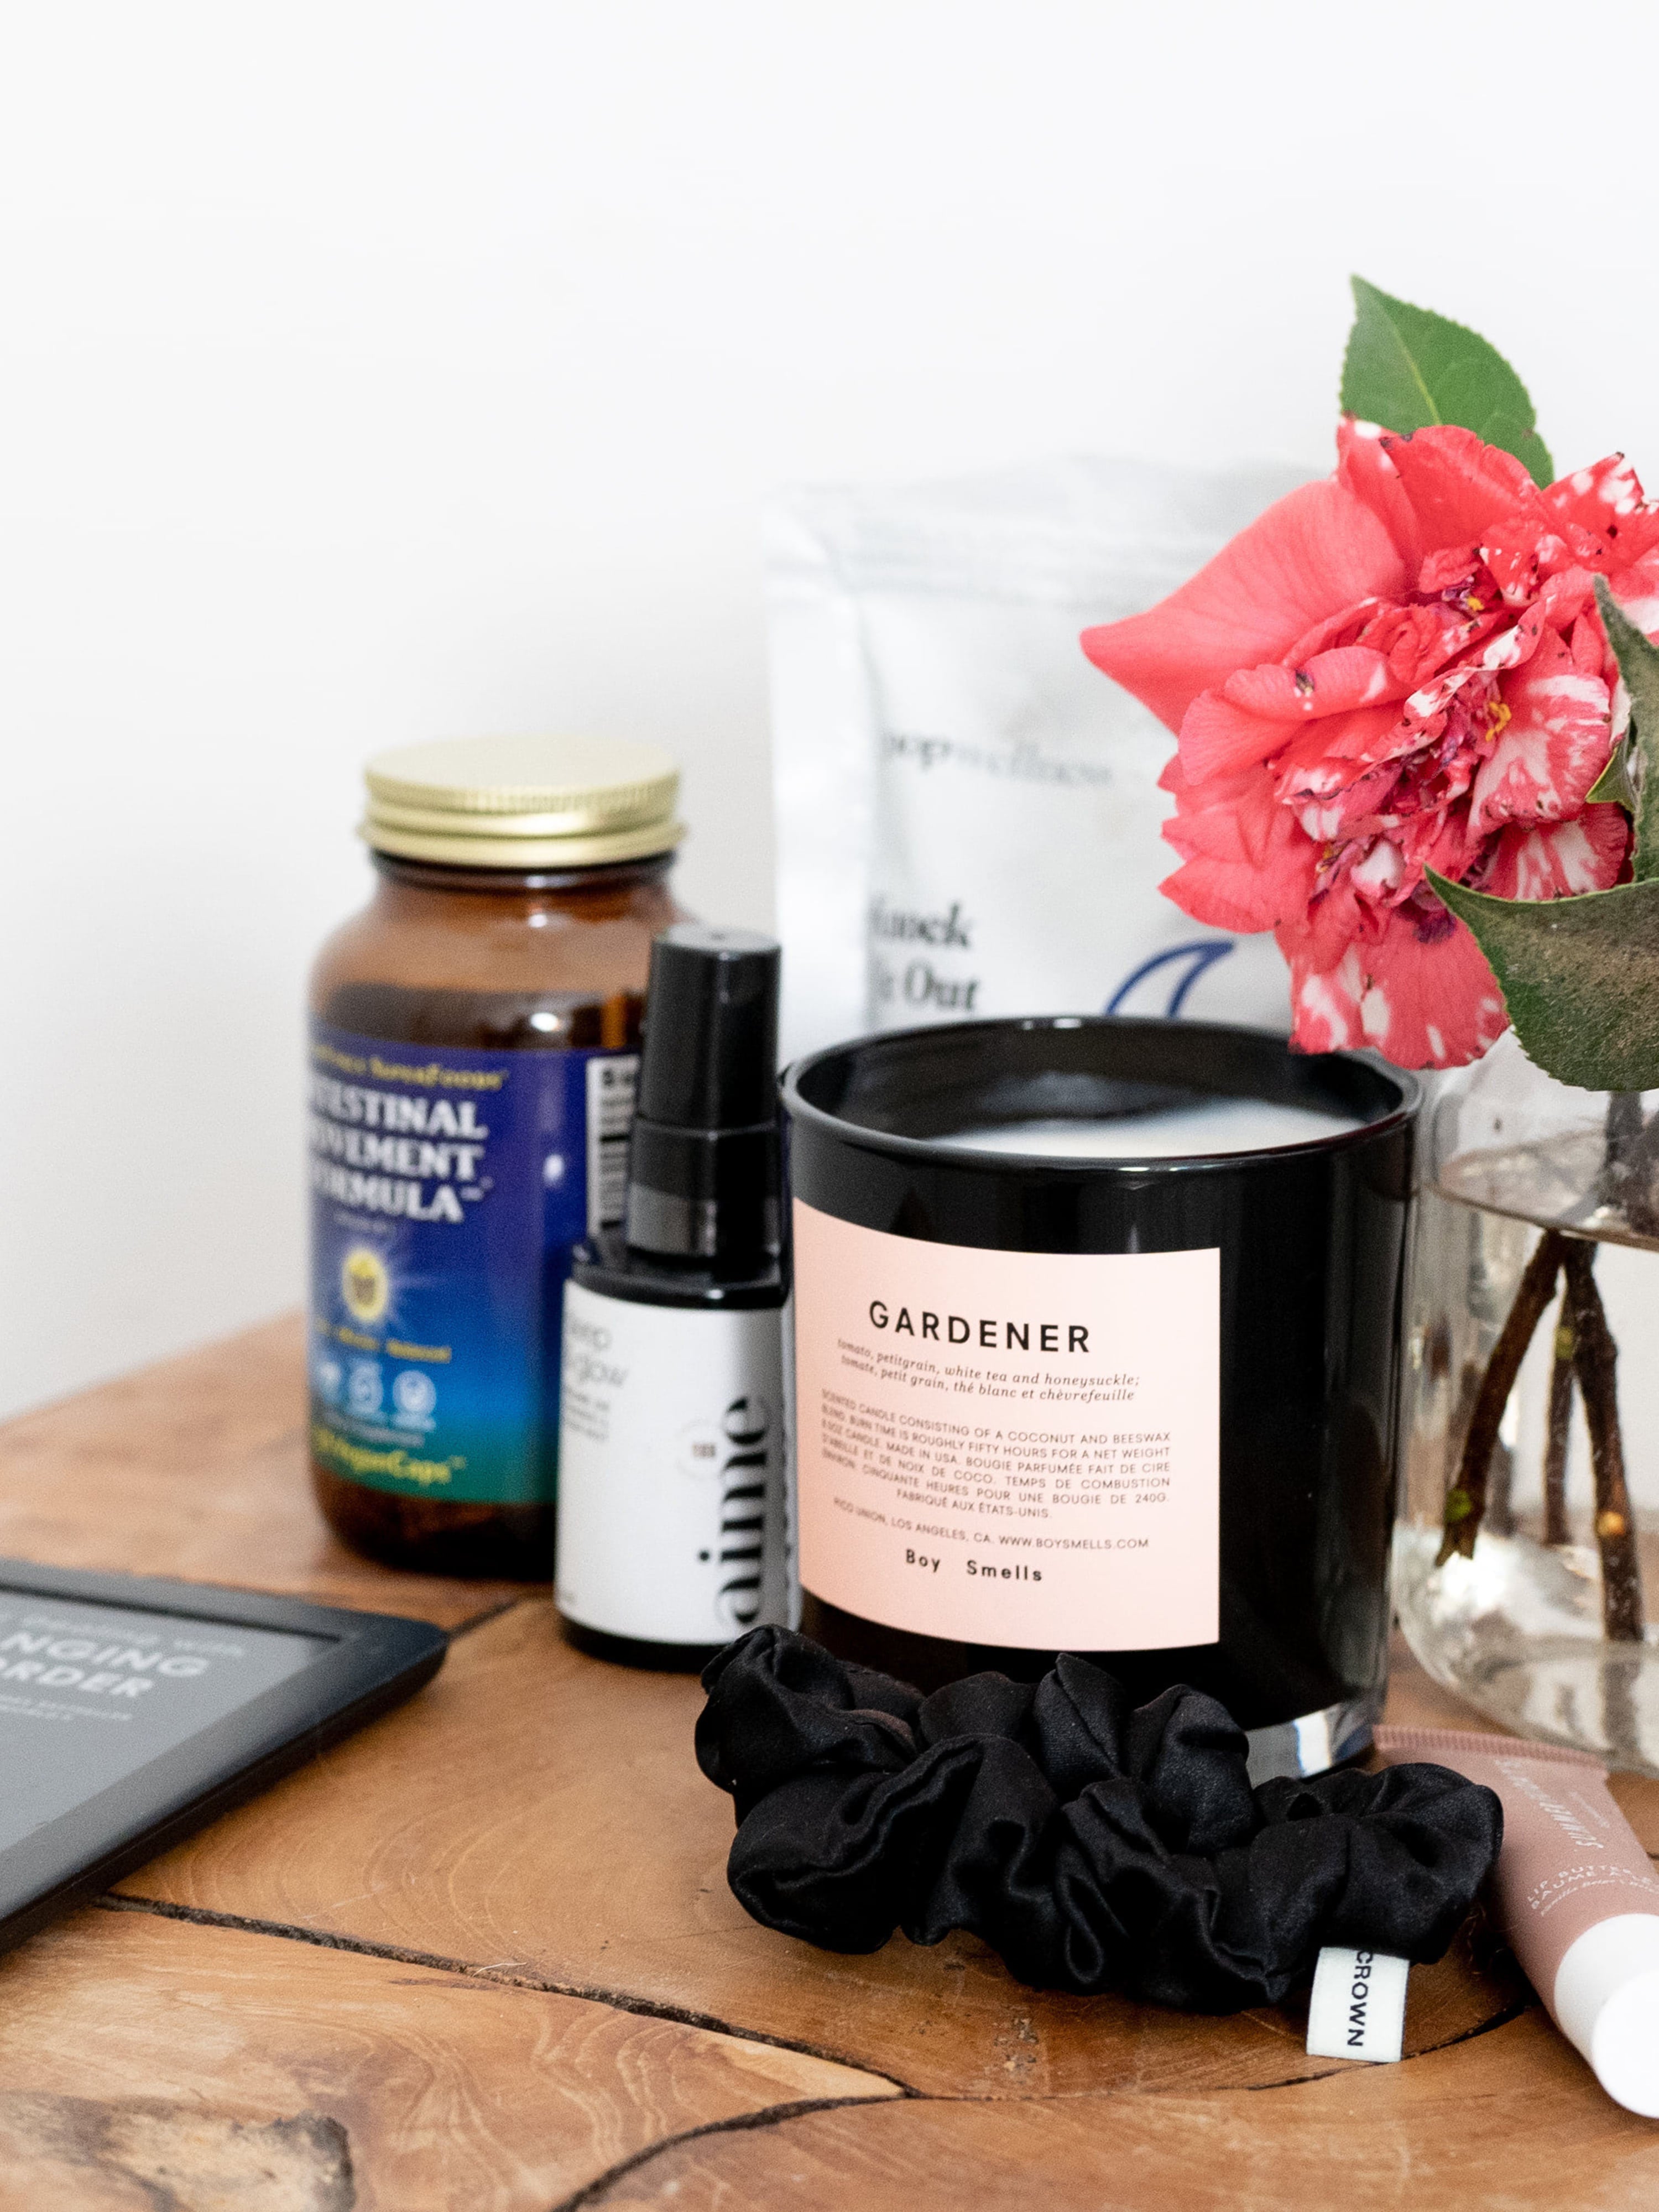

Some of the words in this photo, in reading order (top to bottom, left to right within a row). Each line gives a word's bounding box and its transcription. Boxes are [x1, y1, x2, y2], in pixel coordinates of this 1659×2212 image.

[869, 1300, 1089, 1353] GARDENER
[877, 1352, 940, 1375] petitgrain,
[945, 1364, 982, 1380] white
[986, 1370, 1007, 1383] tea
[1013, 1373, 1040, 1384] and
[1045, 1373, 1141, 1388] honeysuckle;
[880, 1367, 907, 1383] petit
[910, 1374, 949, 1392] grain,
[954, 1380, 974, 1394] thé
[979, 1383, 1016, 1398] blanc
[1022, 1389, 1034, 1399] et
[1040, 1389, 1134, 1404] chèvrefeuille
[859, 1404, 896, 1422] CANDLE
[899, 1415, 969, 1436] CONSISTING
[974, 1427, 991, 1438] OF
[995, 1430, 1003, 1439] A
[1008, 1431, 1075, 1443] COCONUT
[1080, 1434, 1108, 1444] AND
[1113, 1432, 1171, 1443] BEESWAX
[875, 1423, 895, 1437] TIME
[900, 1430, 909, 1441] IS
[912, 1432, 965, 1450] ROUGHLY
[969, 1442, 999, 1454] FIFTY
[1004, 1446, 1047, 1458] HOURS
[1052, 1449, 1077, 1459] FOR
[1082, 1449, 1089, 1459] A
[1094, 1449, 1117, 1459] NET
[1121, 1447, 1171, 1459] WEIGHT
[864, 1449, 874, 1460] ET
[879, 1454, 891, 1465] DE
[899, 1459, 925, 1473] NOIX
[932, 1465, 946, 1478] DE
[1006, 1475, 1046, 1489] TEMPS
[1055, 1479, 1071, 1489] DE
[1081, 1477, 1170, 1489] COMBUSTION
[886, 1442, 915, 1457] MADE
[919, 1449, 930, 1459] IN
[966, 1456, 1012, 1471] BOUGIE
[1018, 1462, 1083, 1474] PARFUMÉE
[1088, 1464, 1114, 1474] FAIT
[1120, 1464, 1136, 1474] DE
[1142, 1462, 1170, 1473] CIRE
[862, 1464, 919, 1487] CINQUANTE
[926, 1480, 969, 1496] HEURES
[977, 1488, 1011, 1500] POUR
[1019, 1493, 1044, 1503] UNE
[1052, 1494, 1102, 1505] BOUGIE
[1110, 1494, 1126, 1504] DE
[1135, 1493, 1170, 1504] 240G.
[897, 1488, 947, 1507] FABRIQUÉ
[952, 1500, 975, 1512] AUX
[699, 1392, 769, 1625] aime
[891, 1517, 912, 1531] LOS
[915, 1523, 969, 1542] ANGELES,
[999, 1535, 1150, 1550] WWW.BOYSMELLS.COM
[906, 1548, 941, 1573] Boy
[967, 1559, 1042, 1582] Smells
[1347, 1949, 1373, 2047] CROWN
